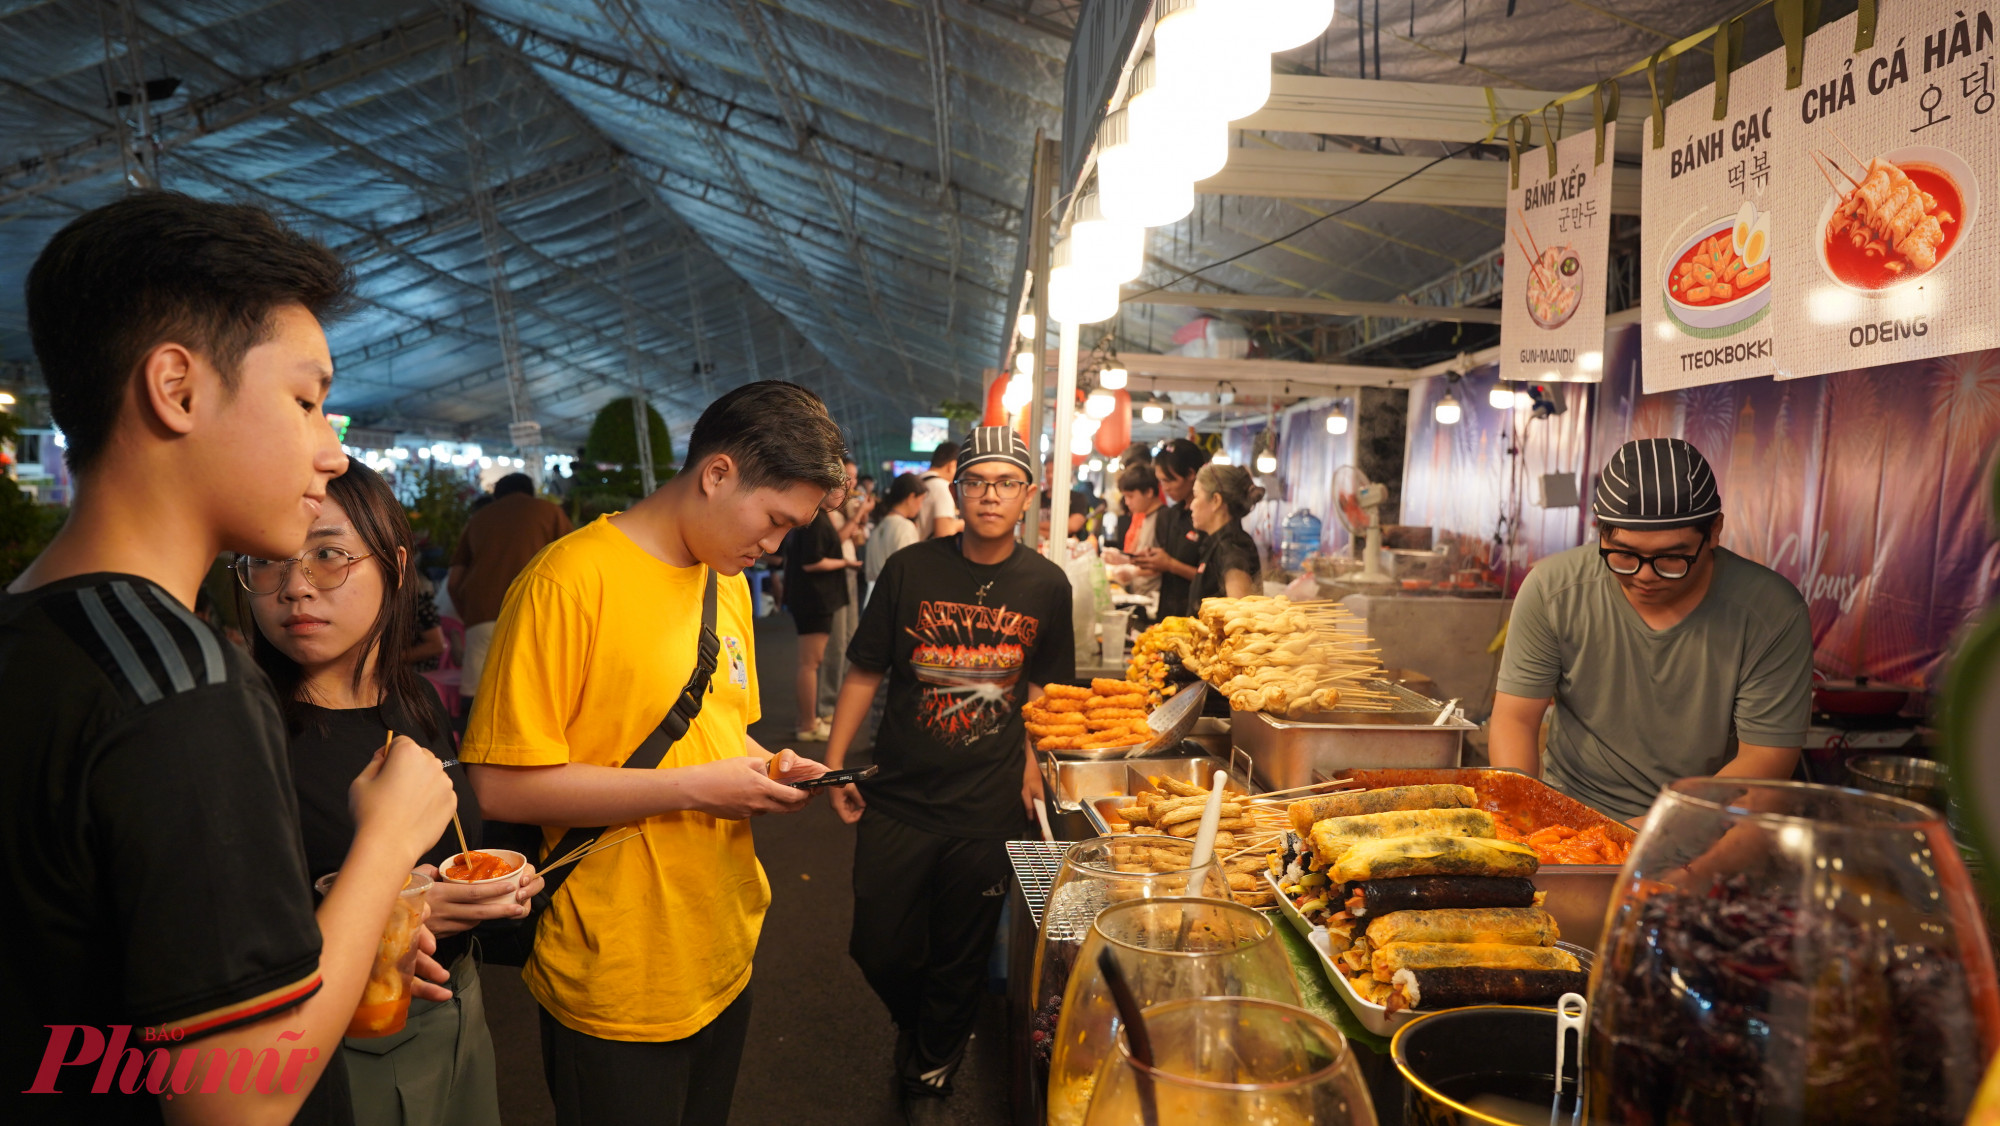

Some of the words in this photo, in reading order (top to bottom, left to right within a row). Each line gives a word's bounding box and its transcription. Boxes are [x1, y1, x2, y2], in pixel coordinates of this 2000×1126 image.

[1801, 58, 1856, 124] CHẢ
[1868, 36, 1909, 96] CÁ
[1923, 10, 1994, 74] HÀN
[1671, 129, 1724, 179] BÁNH
[1524, 178, 1556, 211] BÁNH
[1559, 164, 1586, 203] XẾP
[1558, 200, 1597, 232] 군만두
[1849, 315, 1928, 348] ODENG
[1520, 348, 1575, 364] GUN-MANDU
[1680, 338, 1773, 372] TTEOKBOKKI
